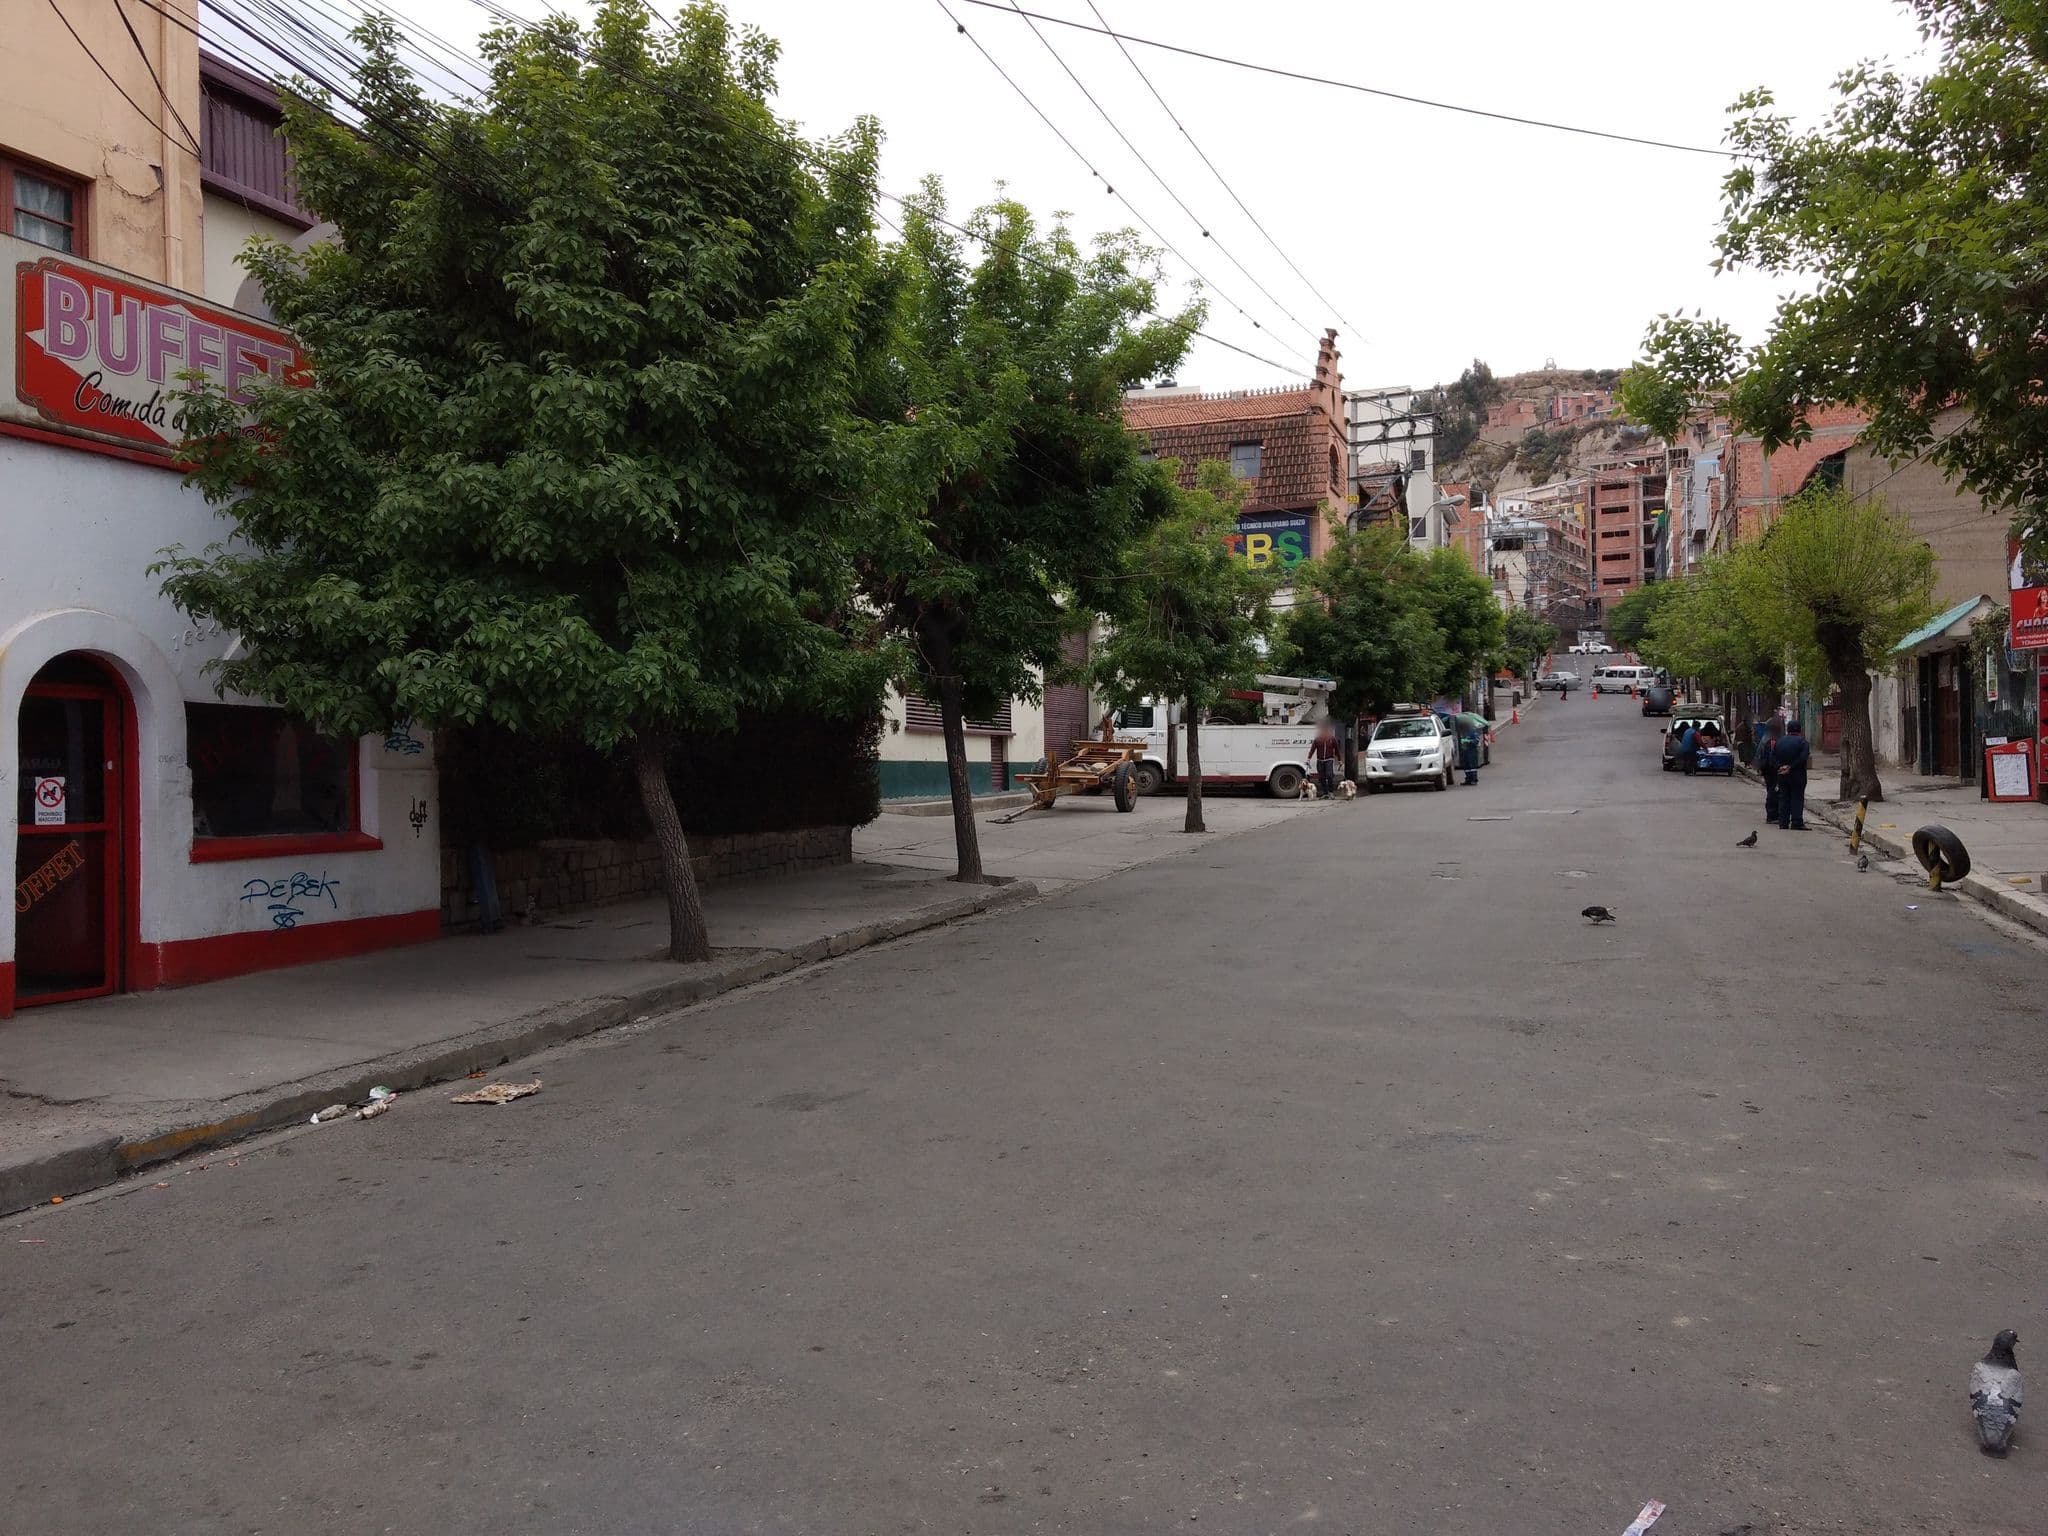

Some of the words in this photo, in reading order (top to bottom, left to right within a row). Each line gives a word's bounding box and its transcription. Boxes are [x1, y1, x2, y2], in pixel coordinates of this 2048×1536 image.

[43, 271, 295, 406] BUFFET
[74, 371, 165, 428] Comida
[1222, 530, 1304, 570] TBS
